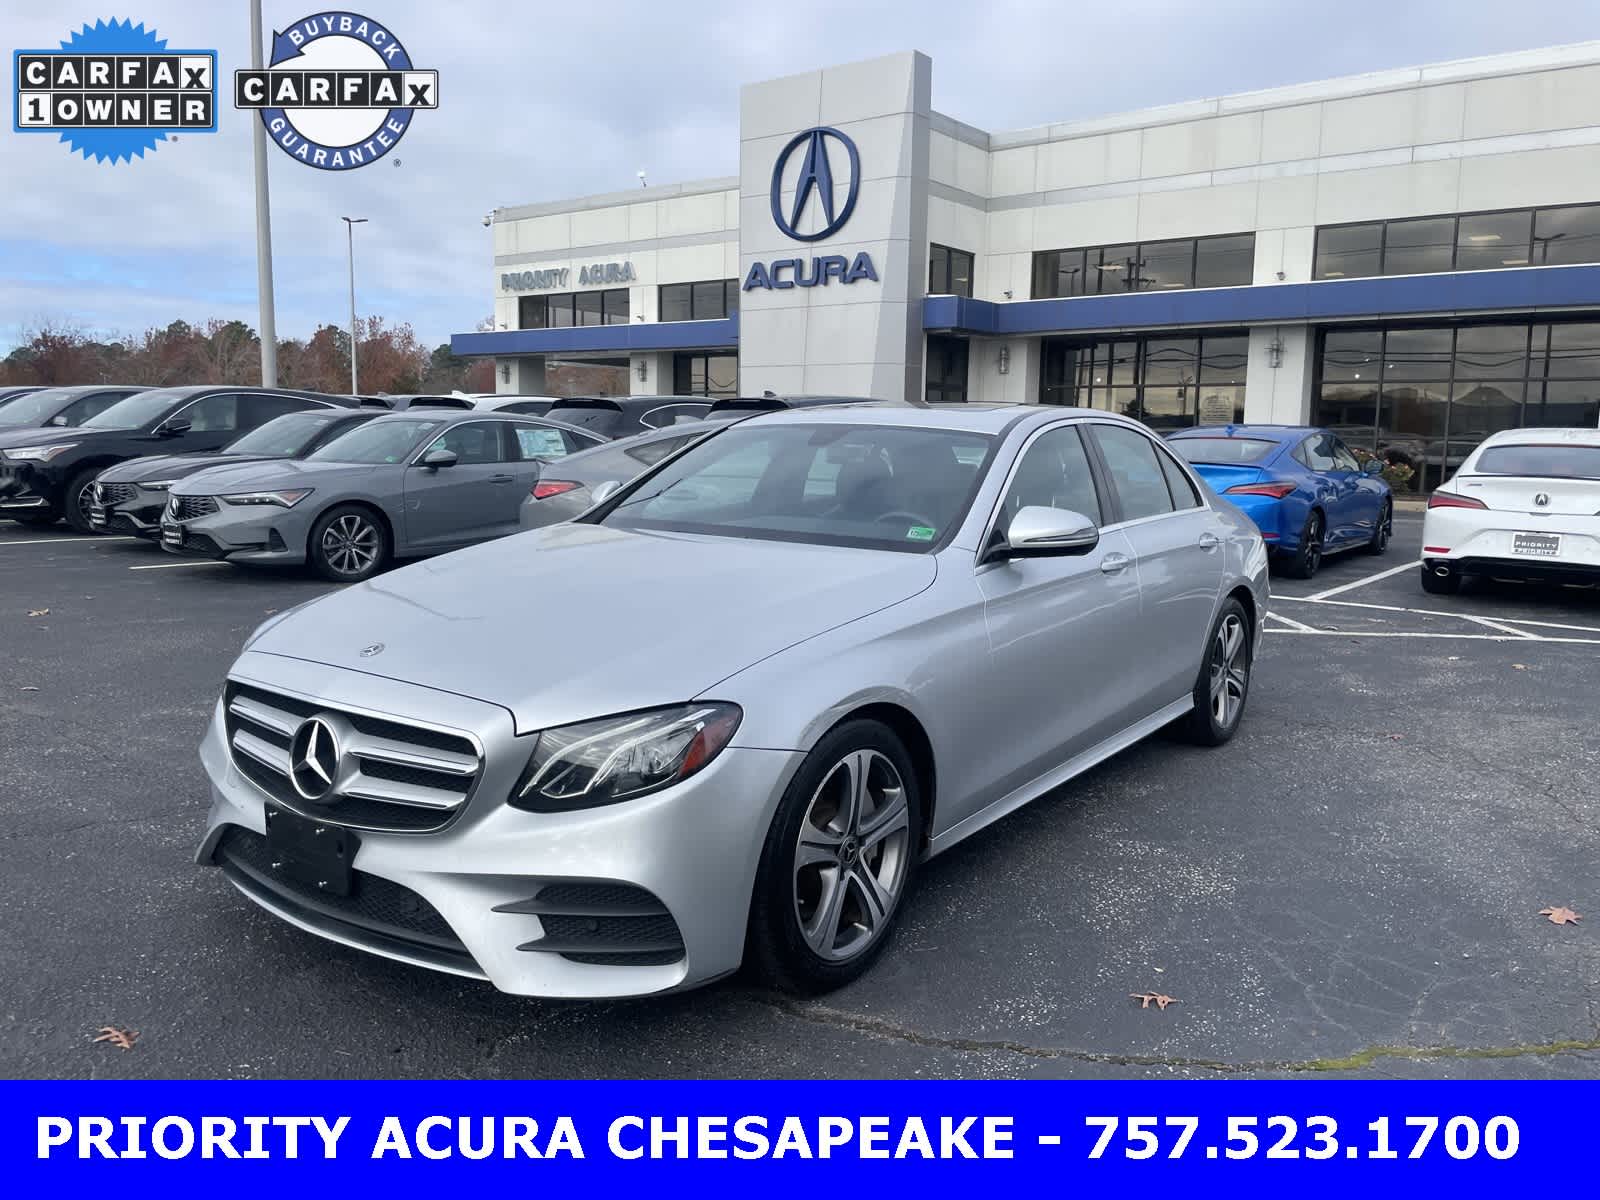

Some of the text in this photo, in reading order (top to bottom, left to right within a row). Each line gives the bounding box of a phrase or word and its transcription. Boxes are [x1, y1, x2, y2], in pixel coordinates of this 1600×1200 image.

[501, 261, 637, 292] PRIORITY ACURA
[742, 251, 879, 292] ACURA
[1515, 541, 1558, 549] PRIORITY
